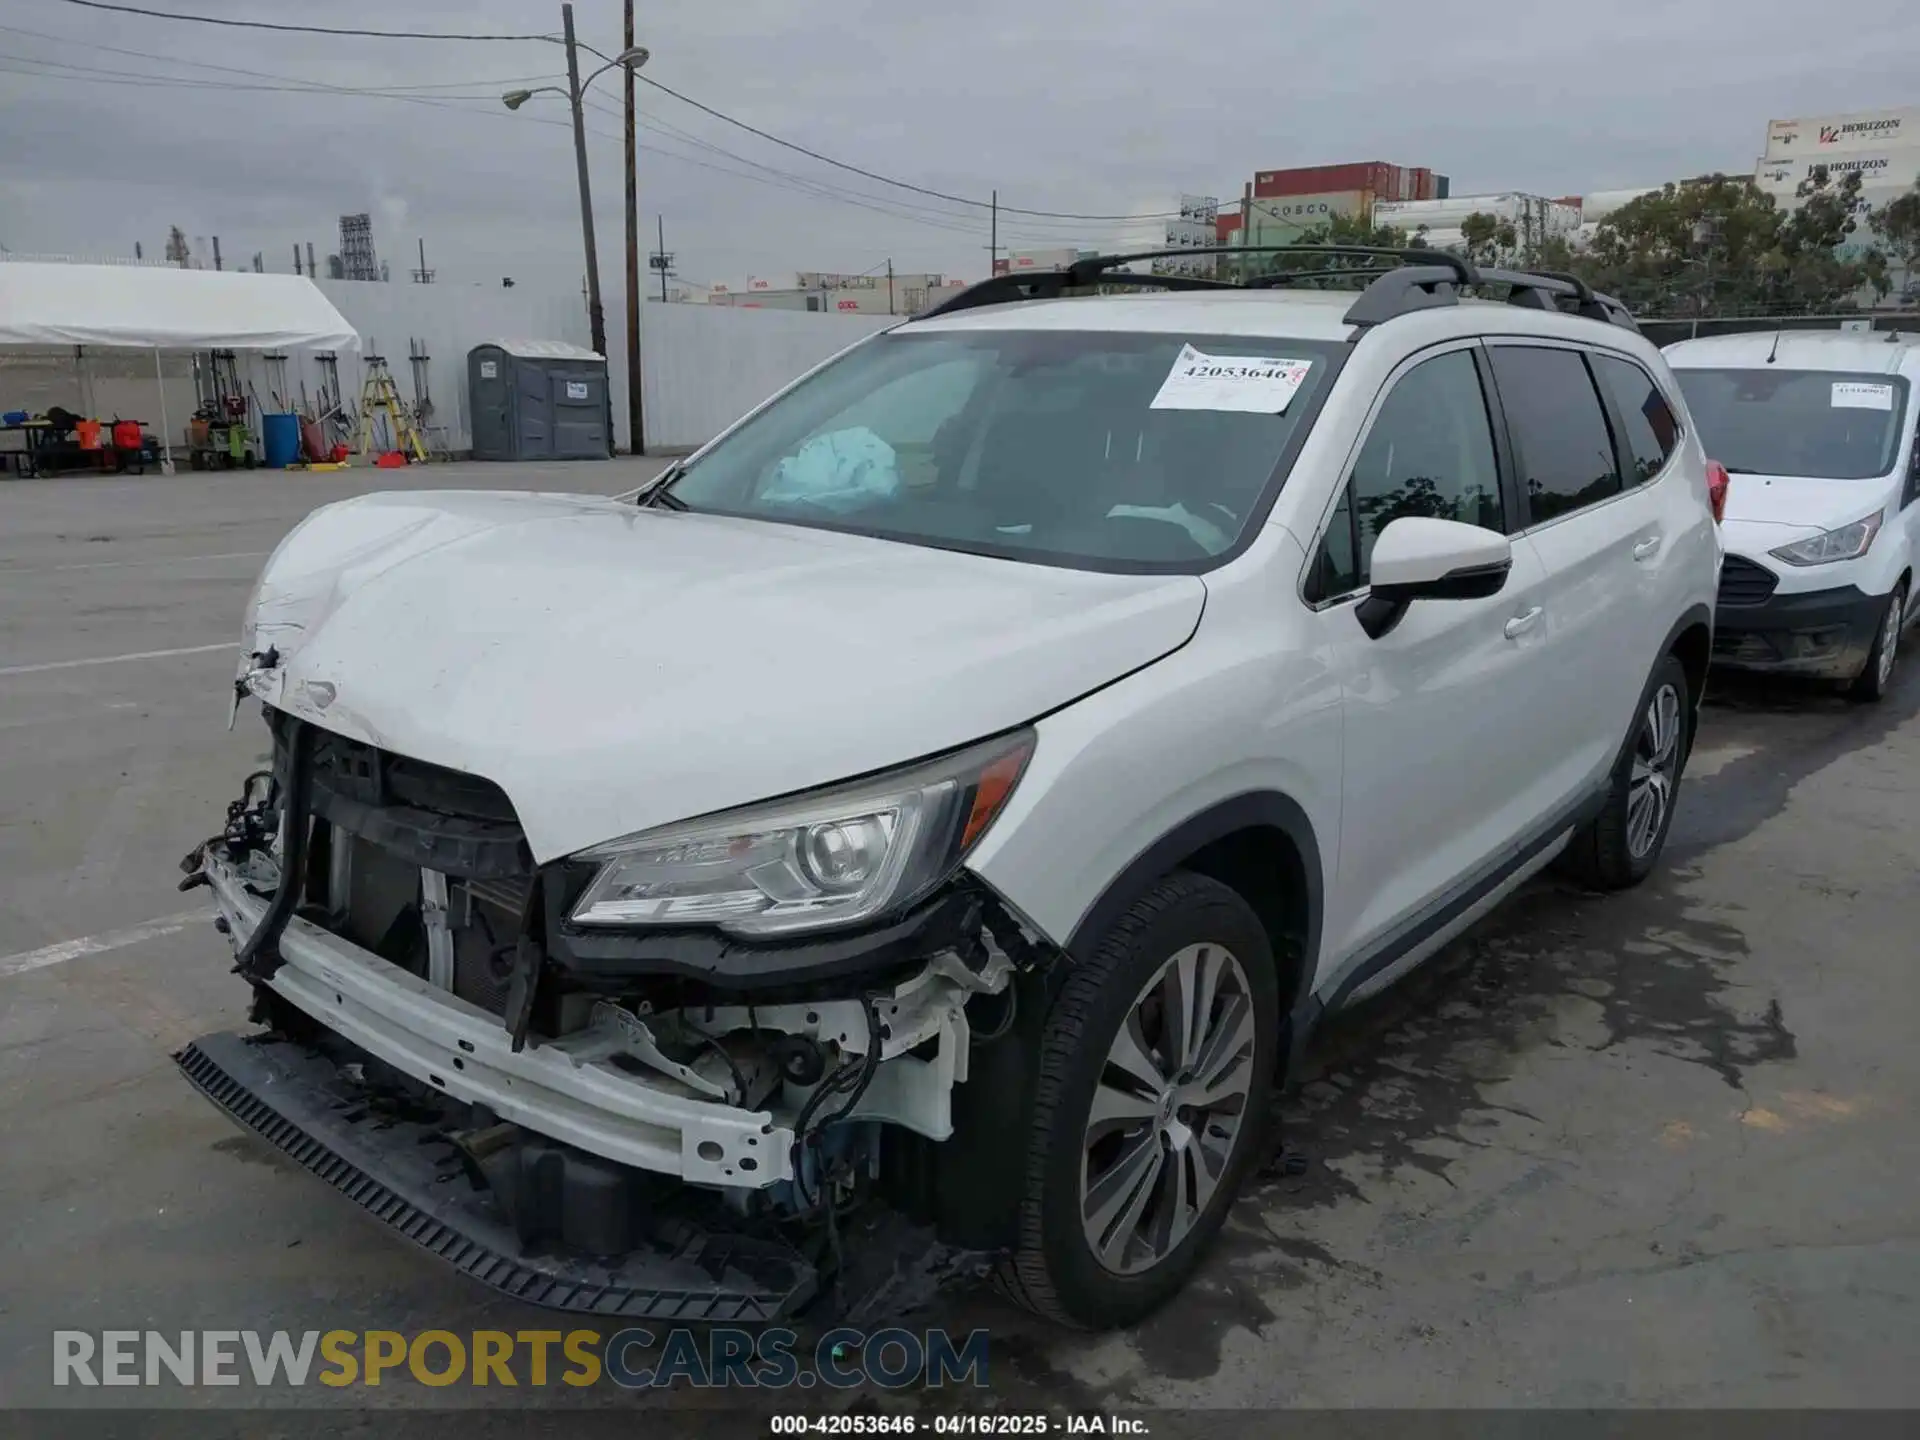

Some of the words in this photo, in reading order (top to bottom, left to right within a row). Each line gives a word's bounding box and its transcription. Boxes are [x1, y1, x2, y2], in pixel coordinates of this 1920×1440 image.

[1841, 119, 1901, 133] HORIZON
[1829, 159, 1889, 172] HORIZON
[1270, 203, 1329, 218] COSCO
[1183, 366, 1288, 379] 42053646
